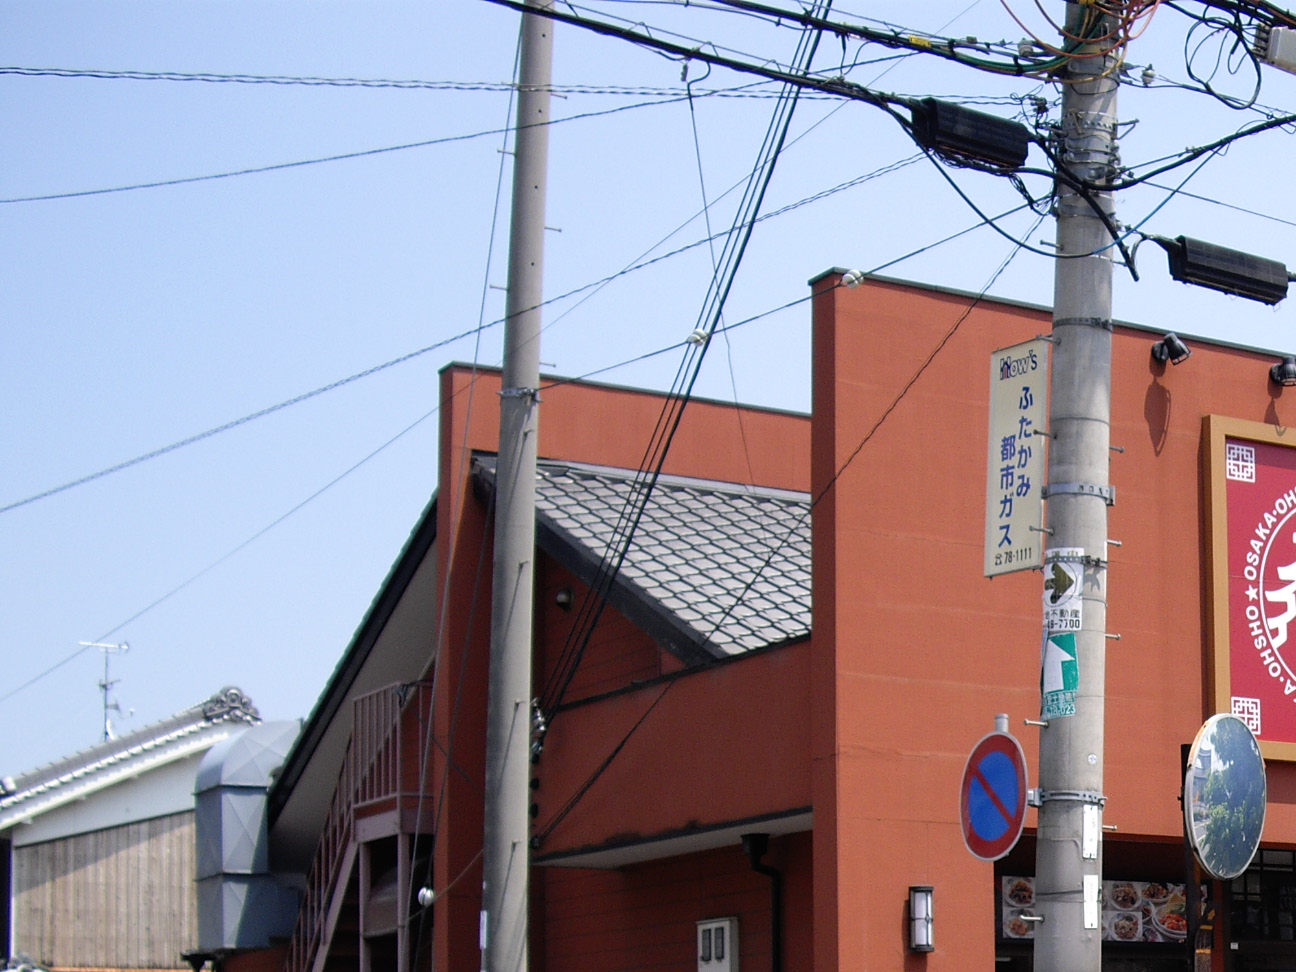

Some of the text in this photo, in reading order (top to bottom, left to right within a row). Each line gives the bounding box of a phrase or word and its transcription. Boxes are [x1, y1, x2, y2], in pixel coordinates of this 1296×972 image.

[998, 435, 1016, 548] 都市ガス
[1015, 386, 1033, 498] ふたかみ
